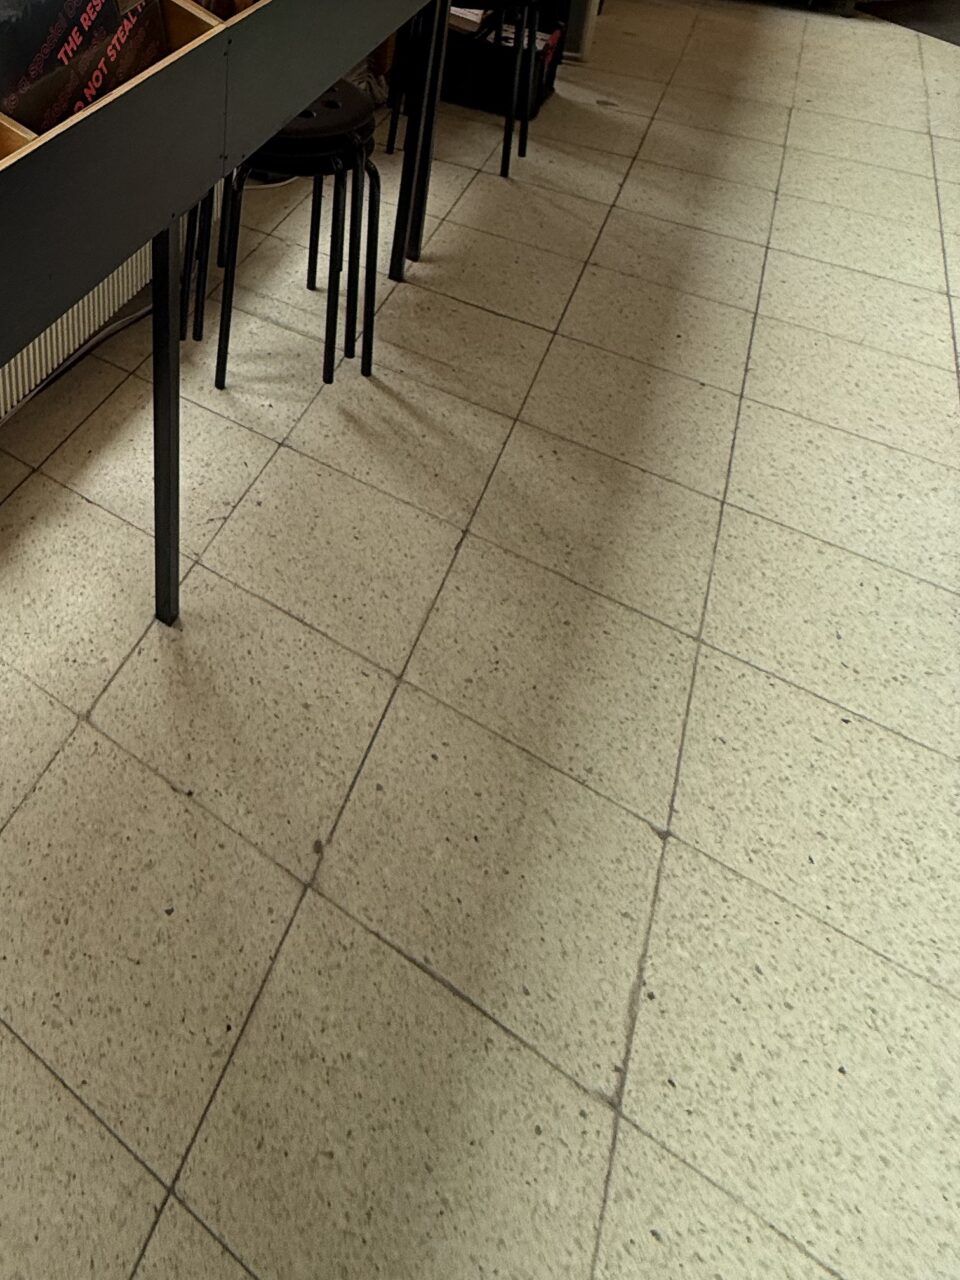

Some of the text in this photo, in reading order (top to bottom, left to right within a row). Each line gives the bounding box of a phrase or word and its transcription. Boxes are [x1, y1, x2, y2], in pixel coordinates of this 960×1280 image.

[57, 26, 84, 66] THE
[83, 57, 108, 102] NOT
[107, 10, 138, 62] STEAL
